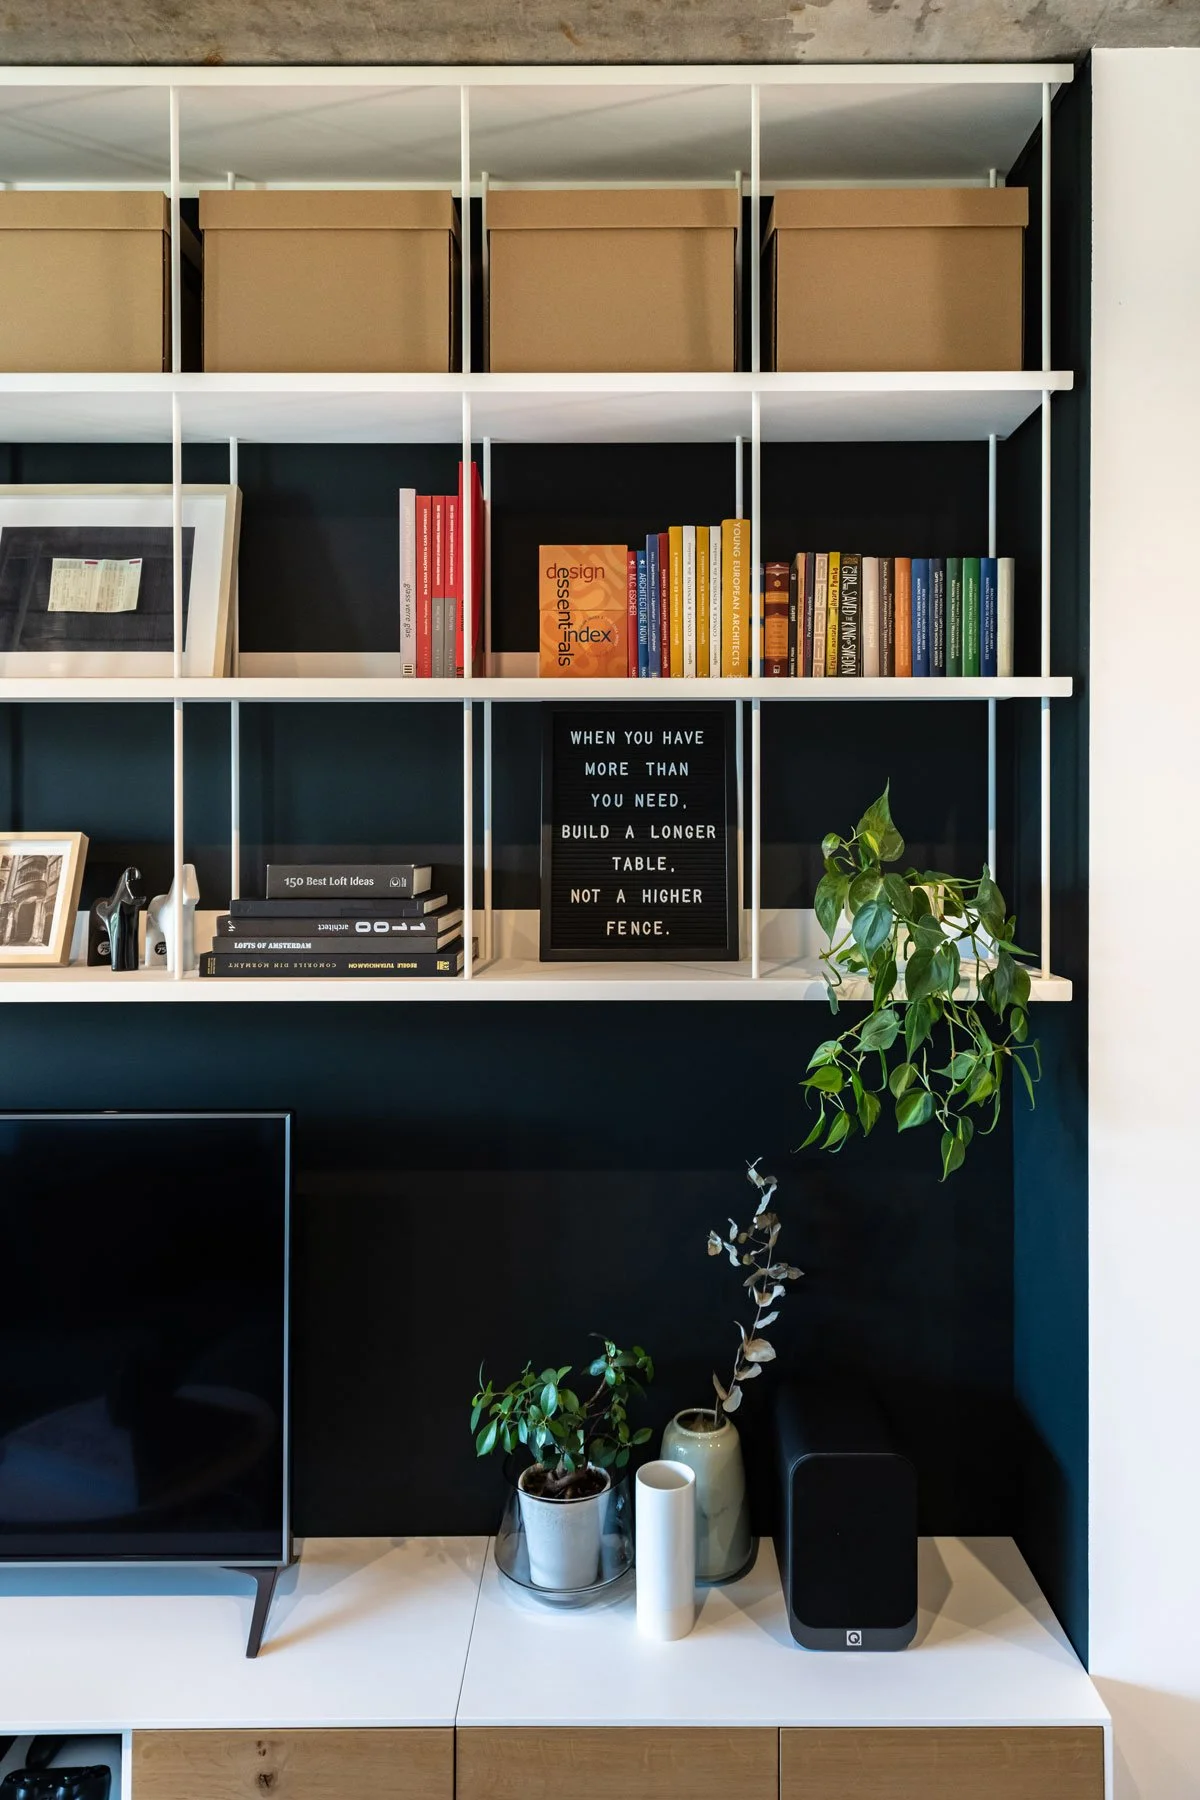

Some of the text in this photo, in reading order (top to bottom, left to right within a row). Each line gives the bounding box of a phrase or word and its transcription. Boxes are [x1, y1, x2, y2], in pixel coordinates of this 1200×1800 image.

[546, 563, 604, 583] design
[830, 567, 838, 587] Pombo
[842, 566, 857, 587] GIRL
[404, 583, 412, 601] glass
[732, 522, 741, 666] YOUNG EUROPEAN ARCHITECTS
[842, 591, 857, 615] SAVED
[404, 623, 412, 638] glas
[564, 627, 611, 642] index
[841, 622, 857, 640] KING
[841, 645, 857, 674] SWEDEN
[570, 731, 704, 745] WHEN YOU HAVE
[585, 762, 689, 776] MORE THAN
[591, 793, 687, 810] YOU NEED,
[561, 824, 716, 839] BUILD A LONGER
[612, 856, 675, 872] TABLE,
[284, 876, 374, 888] 150 Best Loft Ideas
[571, 888, 703, 904] NOT A HIGHER
[318, 923, 349, 932] architect
[606, 921, 670, 935] FENCE.
